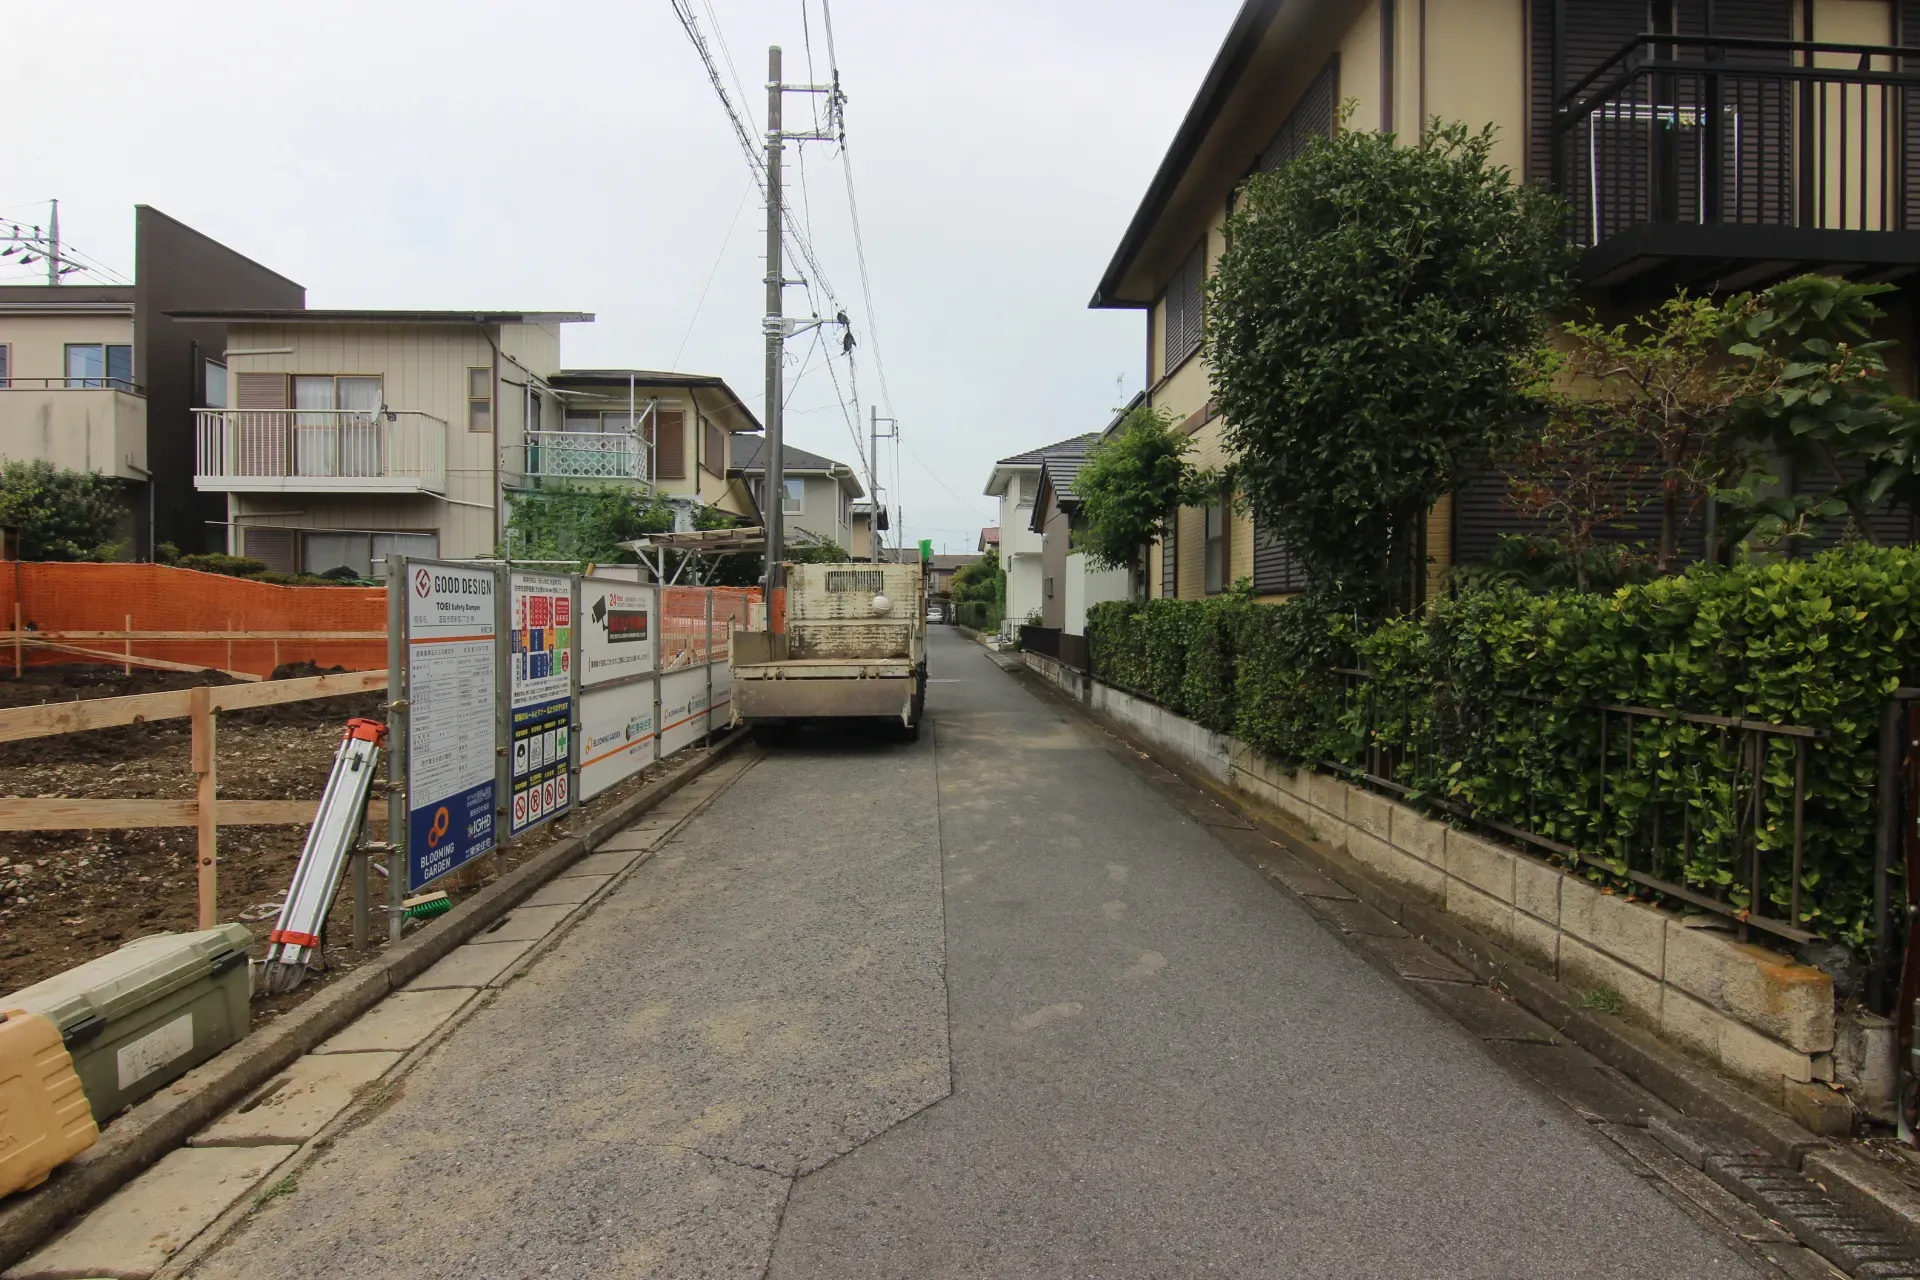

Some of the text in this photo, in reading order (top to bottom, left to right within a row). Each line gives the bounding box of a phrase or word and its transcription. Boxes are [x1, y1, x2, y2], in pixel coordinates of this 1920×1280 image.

[435, 575, 460, 594] GOOD
[462, 578, 492, 596] DESIGN
[609, 593, 617, 607] 24
[420, 842, 455, 869] BLOOMING
[424, 857, 451, 880] GARDEN
